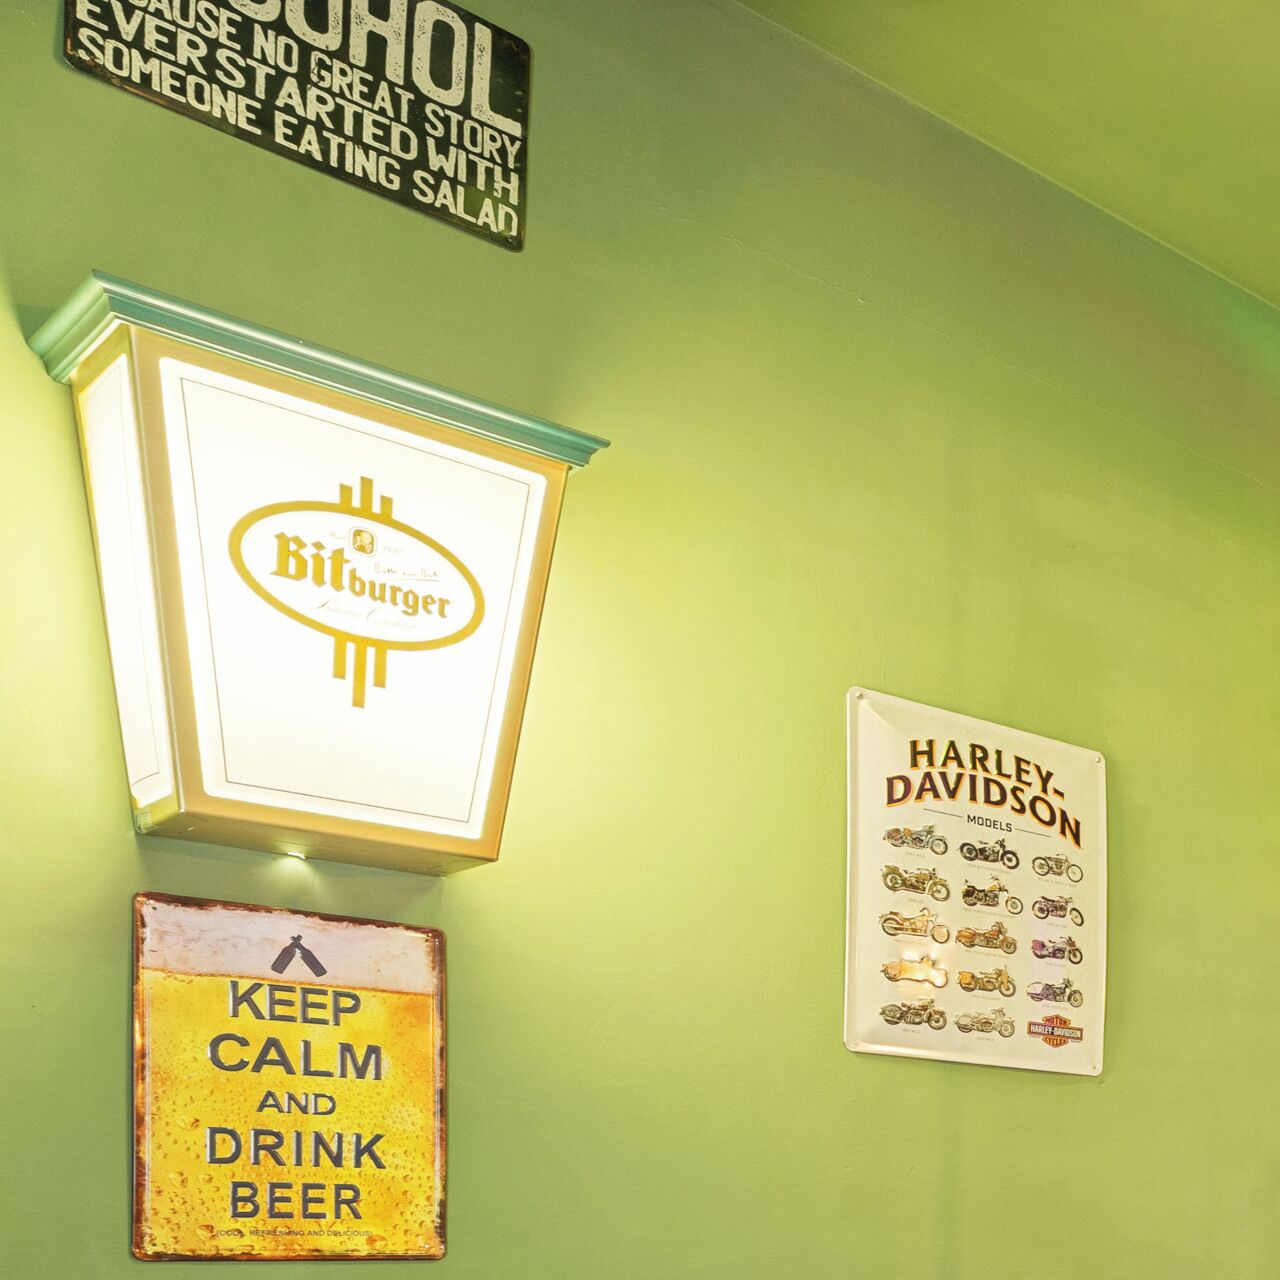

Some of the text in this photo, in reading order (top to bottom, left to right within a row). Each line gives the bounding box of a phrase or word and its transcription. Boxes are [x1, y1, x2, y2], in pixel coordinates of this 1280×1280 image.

[76, 0, 520, 206] EVER STARTED WITH
[253, 23, 299, 73] NO
[311, 51, 414, 124] GREAT
[425, 102, 522, 169] STORY
[78, 27, 518, 238] SOMEONE EATING SALAD
[270, 531, 450, 619] Bitburger
[909, 738, 1065, 800] HARLEY-
[885, 770, 1082, 849] DAVIDSON
[966, 813, 1013, 833] MODELS
[229, 980, 361, 1026] KEEP
[208, 1034, 382, 1080] CALM
[256, 1090, 336, 1115] AND
[206, 1127, 387, 1169] DRINK
[229, 1181, 362, 1219] BEER
[307, 1229, 325, 1237] AND
